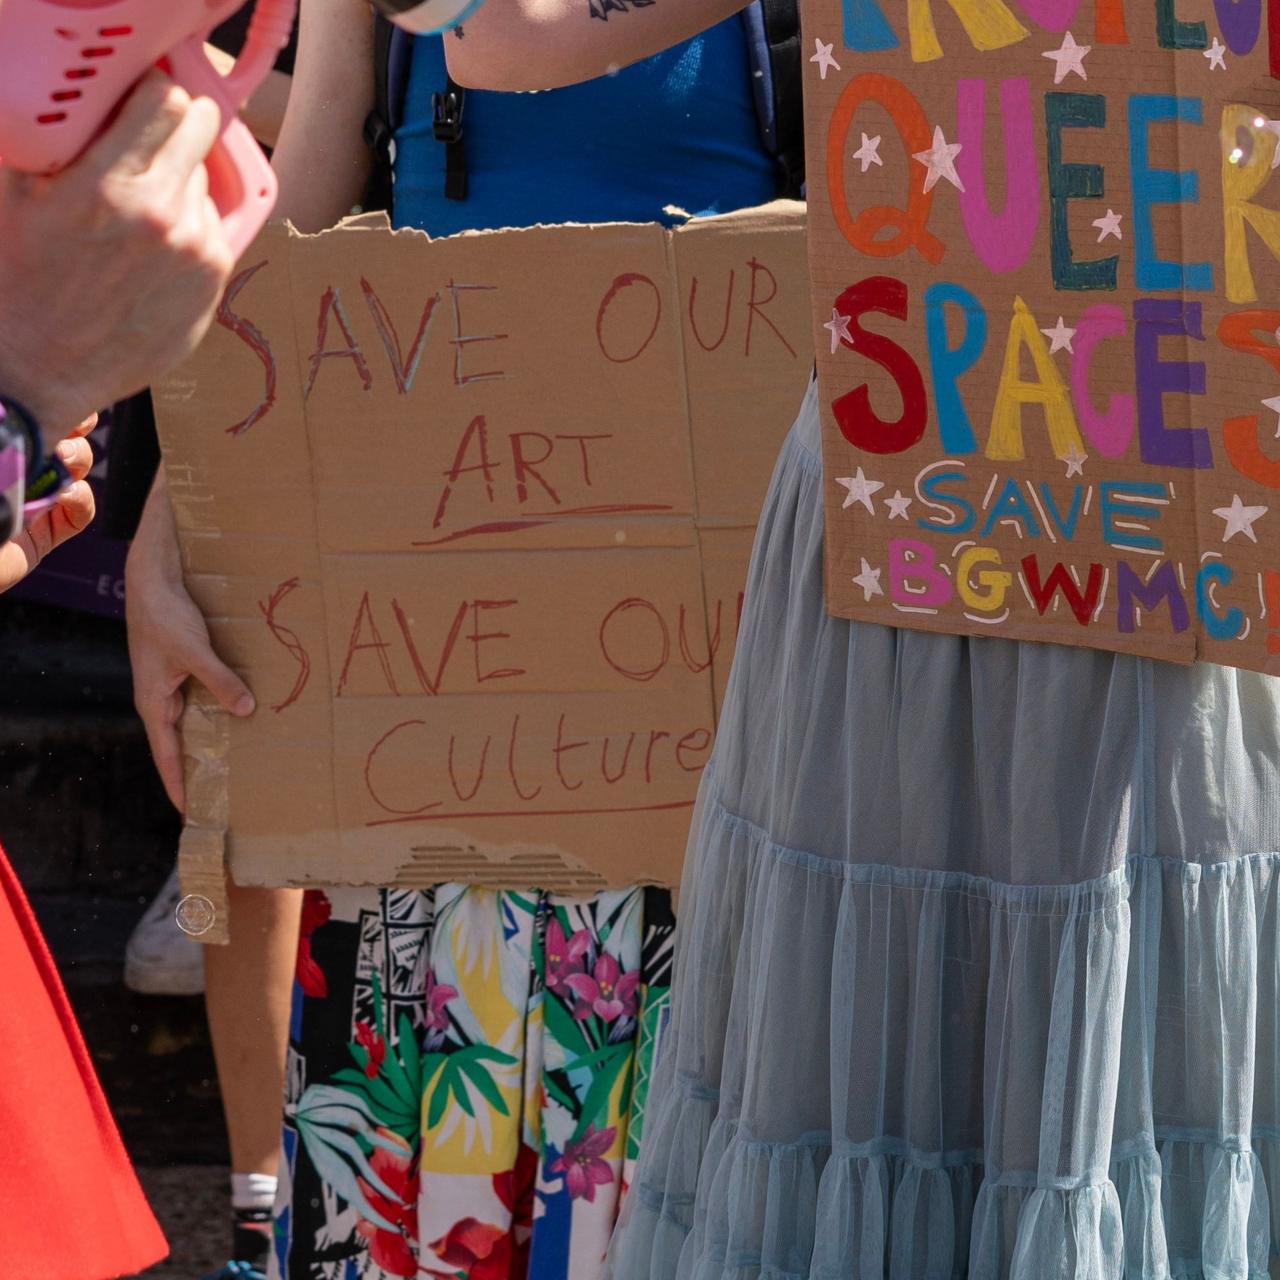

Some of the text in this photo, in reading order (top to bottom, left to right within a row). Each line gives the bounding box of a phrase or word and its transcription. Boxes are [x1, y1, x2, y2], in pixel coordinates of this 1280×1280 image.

[217, 257, 798, 437] SAVE OUR
[432, 414, 614, 529] ART
[916, 465, 1169, 553] SAVE
[258, 575, 744, 713] SAVE OU
[365, 713, 712, 814] Culture
